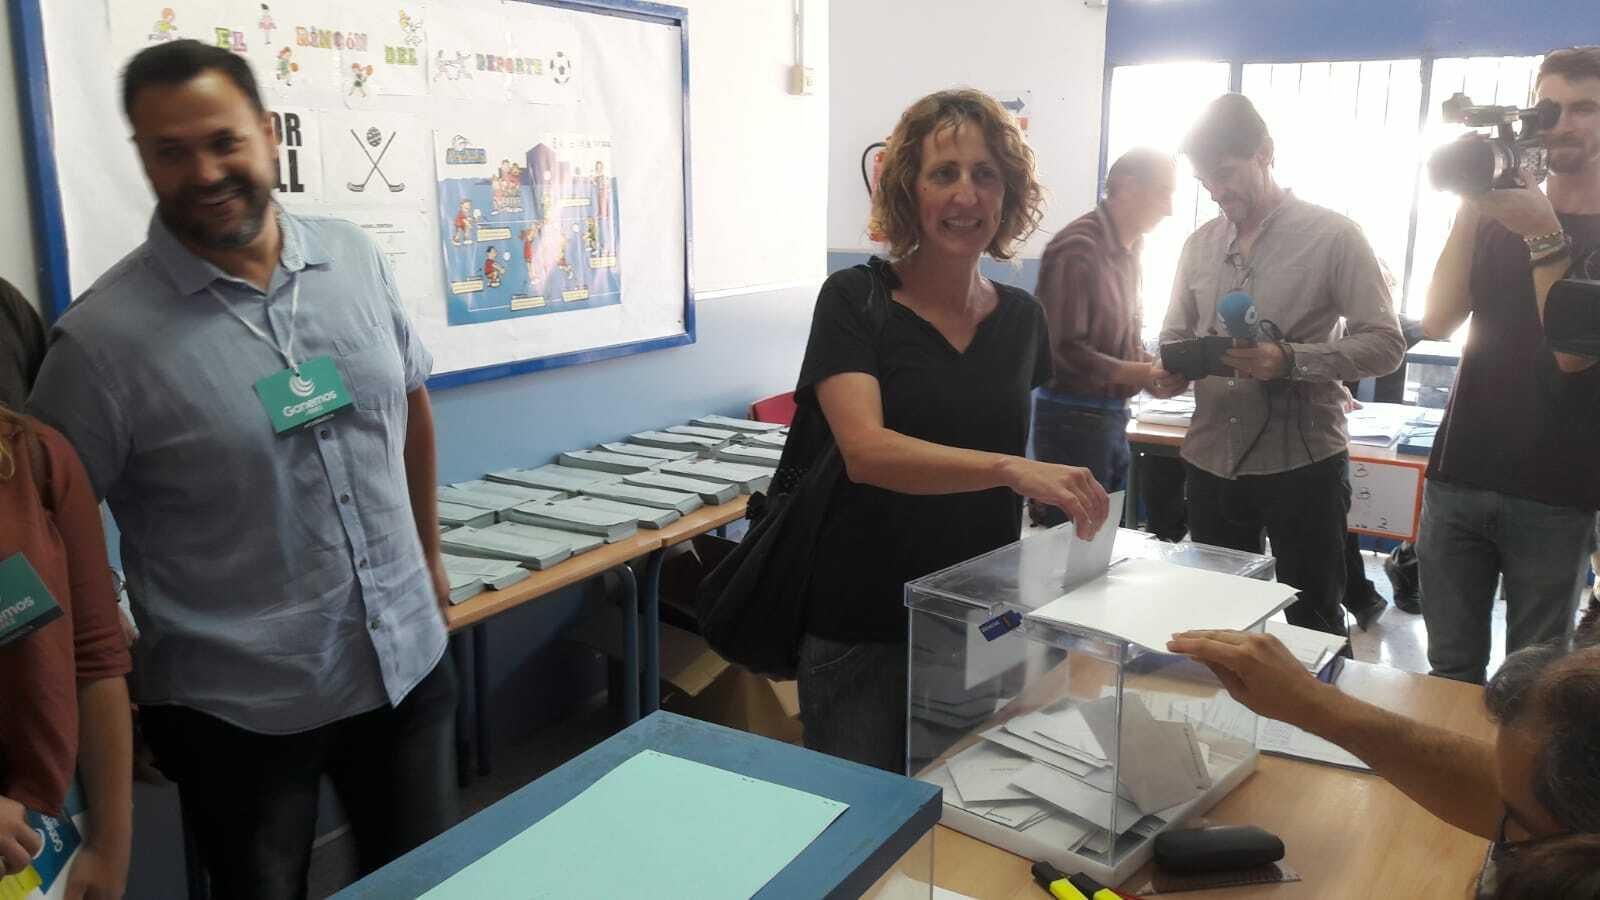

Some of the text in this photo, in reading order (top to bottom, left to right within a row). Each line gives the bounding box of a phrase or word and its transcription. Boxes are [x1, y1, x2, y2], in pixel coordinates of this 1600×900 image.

[215, 27, 248, 52] EL
[385, 46, 418, 66] DEL
[476, 53, 543, 75] DEPORTE
[271, 111, 302, 146] OR
